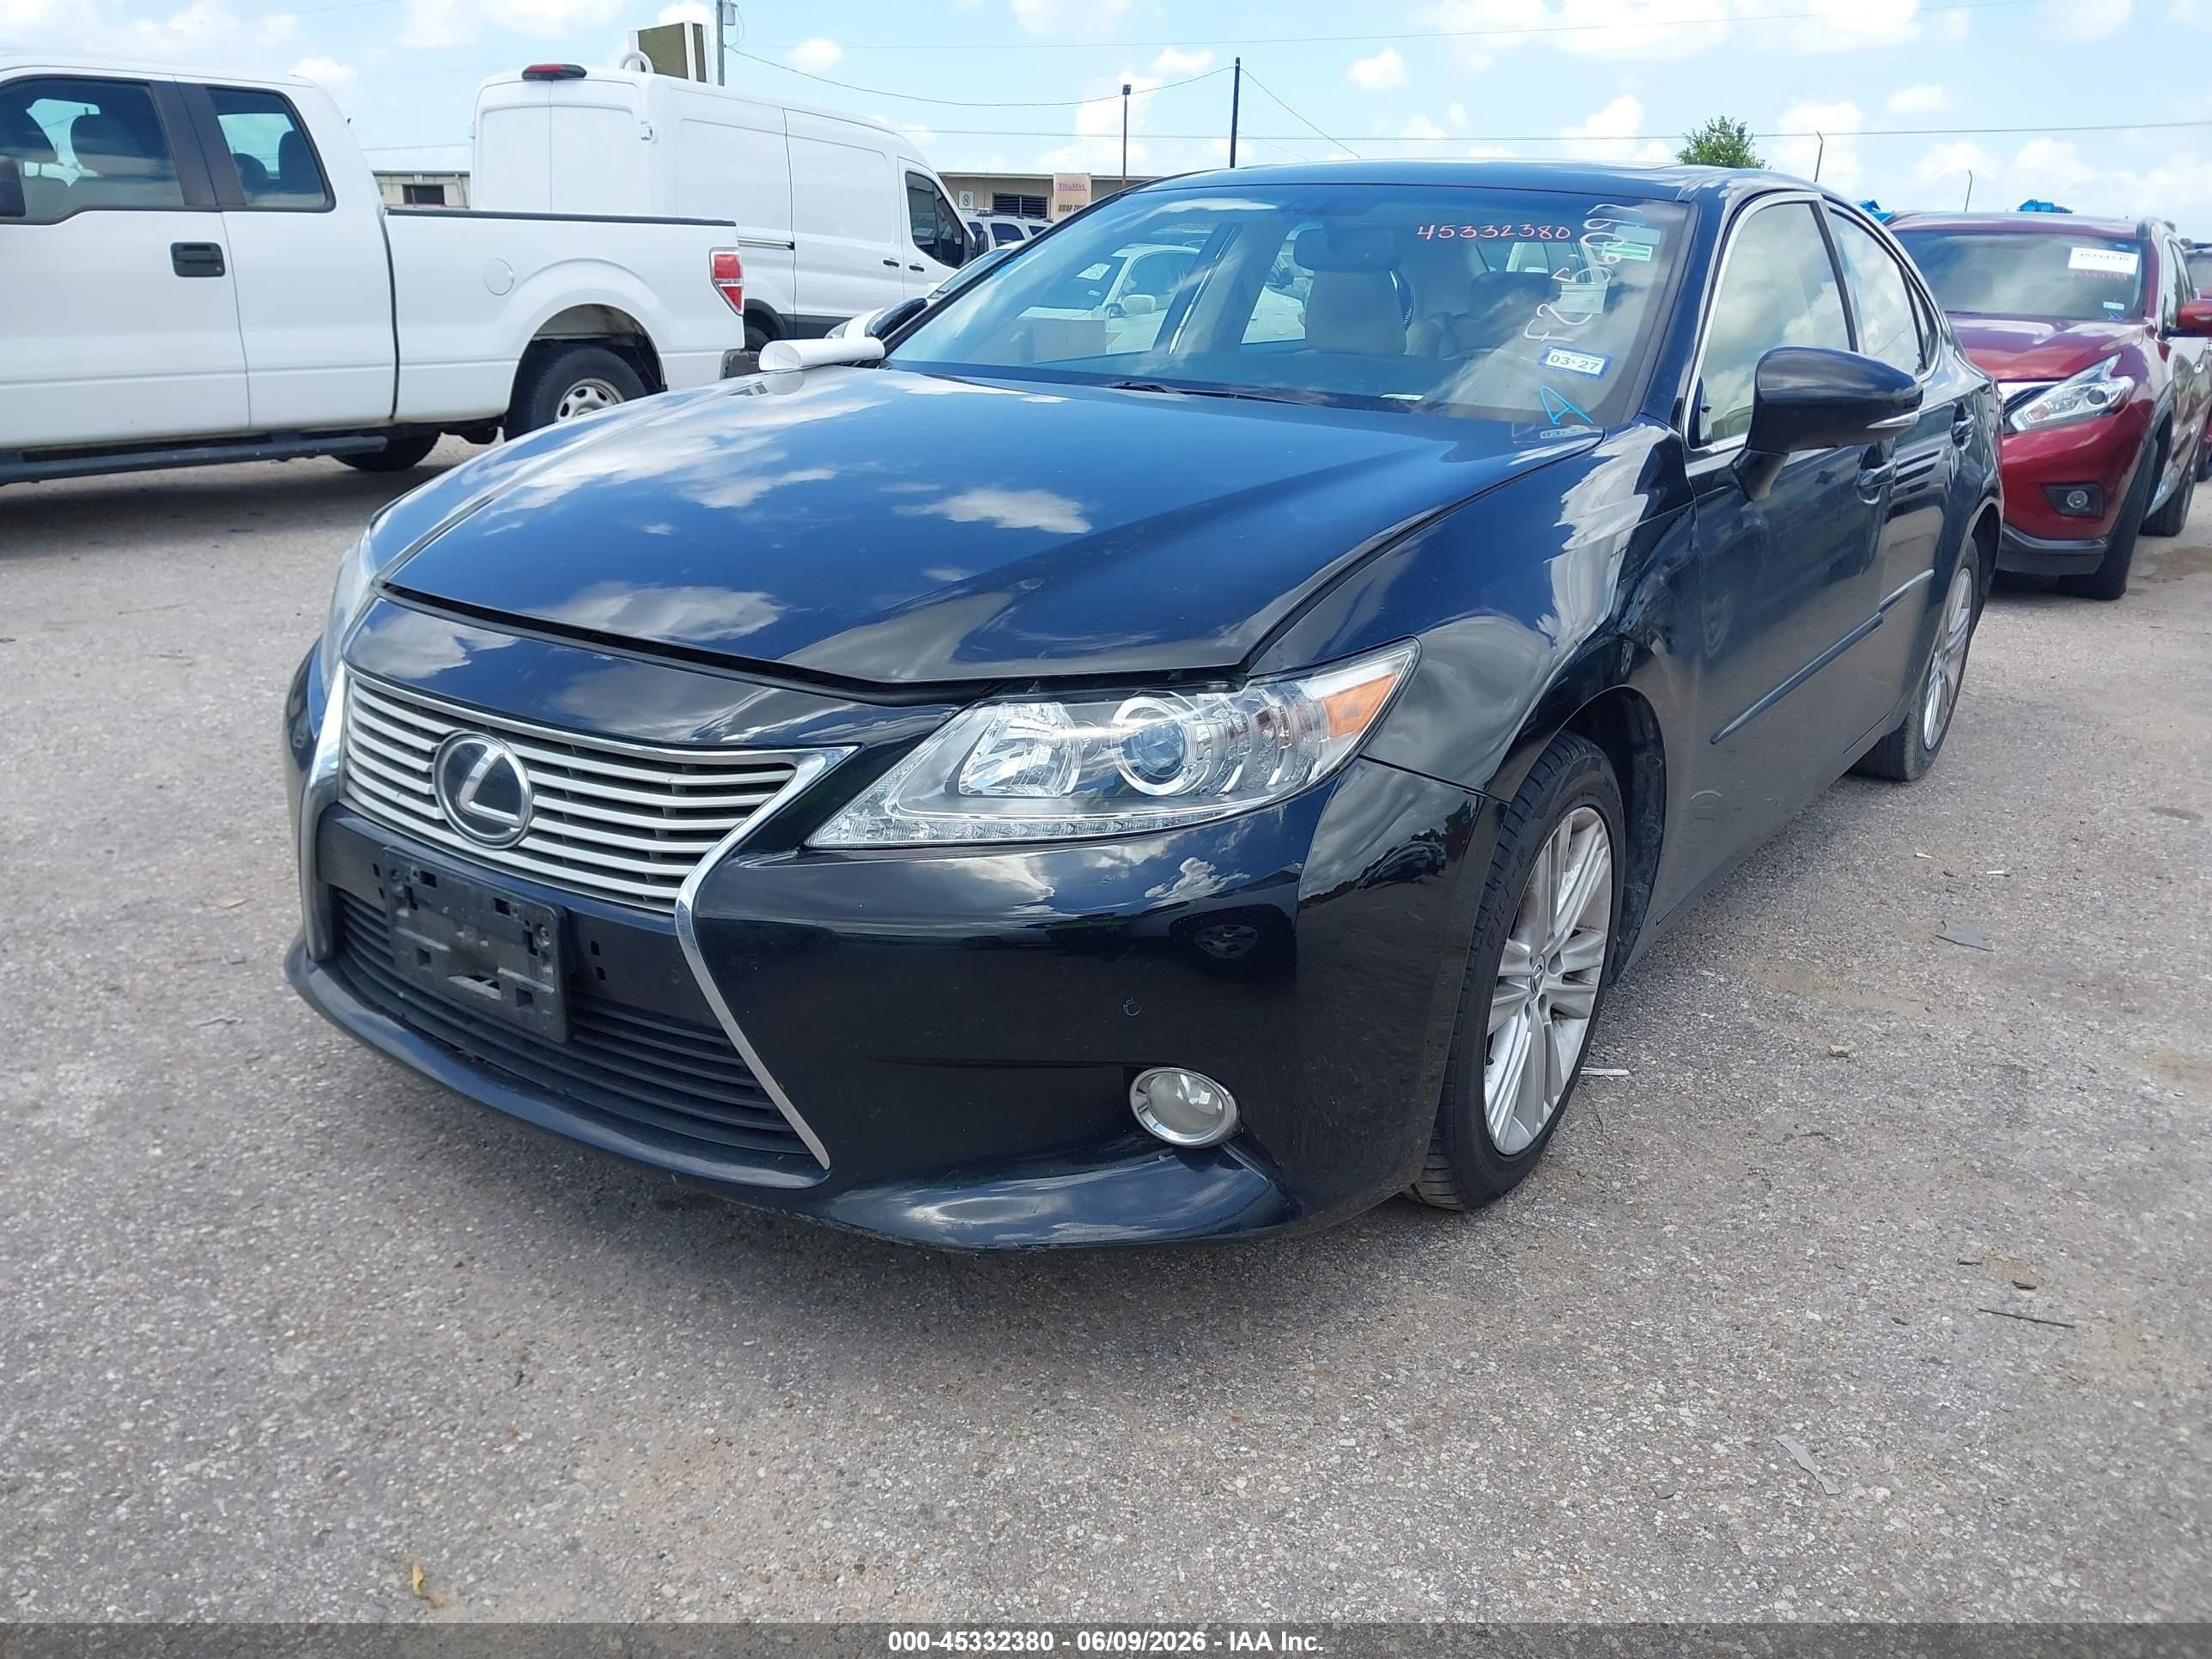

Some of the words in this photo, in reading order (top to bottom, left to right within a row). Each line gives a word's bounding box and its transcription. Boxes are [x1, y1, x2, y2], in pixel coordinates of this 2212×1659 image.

[1416, 223, 1571, 240] 45332380
[1550, 354, 1571, 365] 03
[1577, 359, 1601, 370] 27
